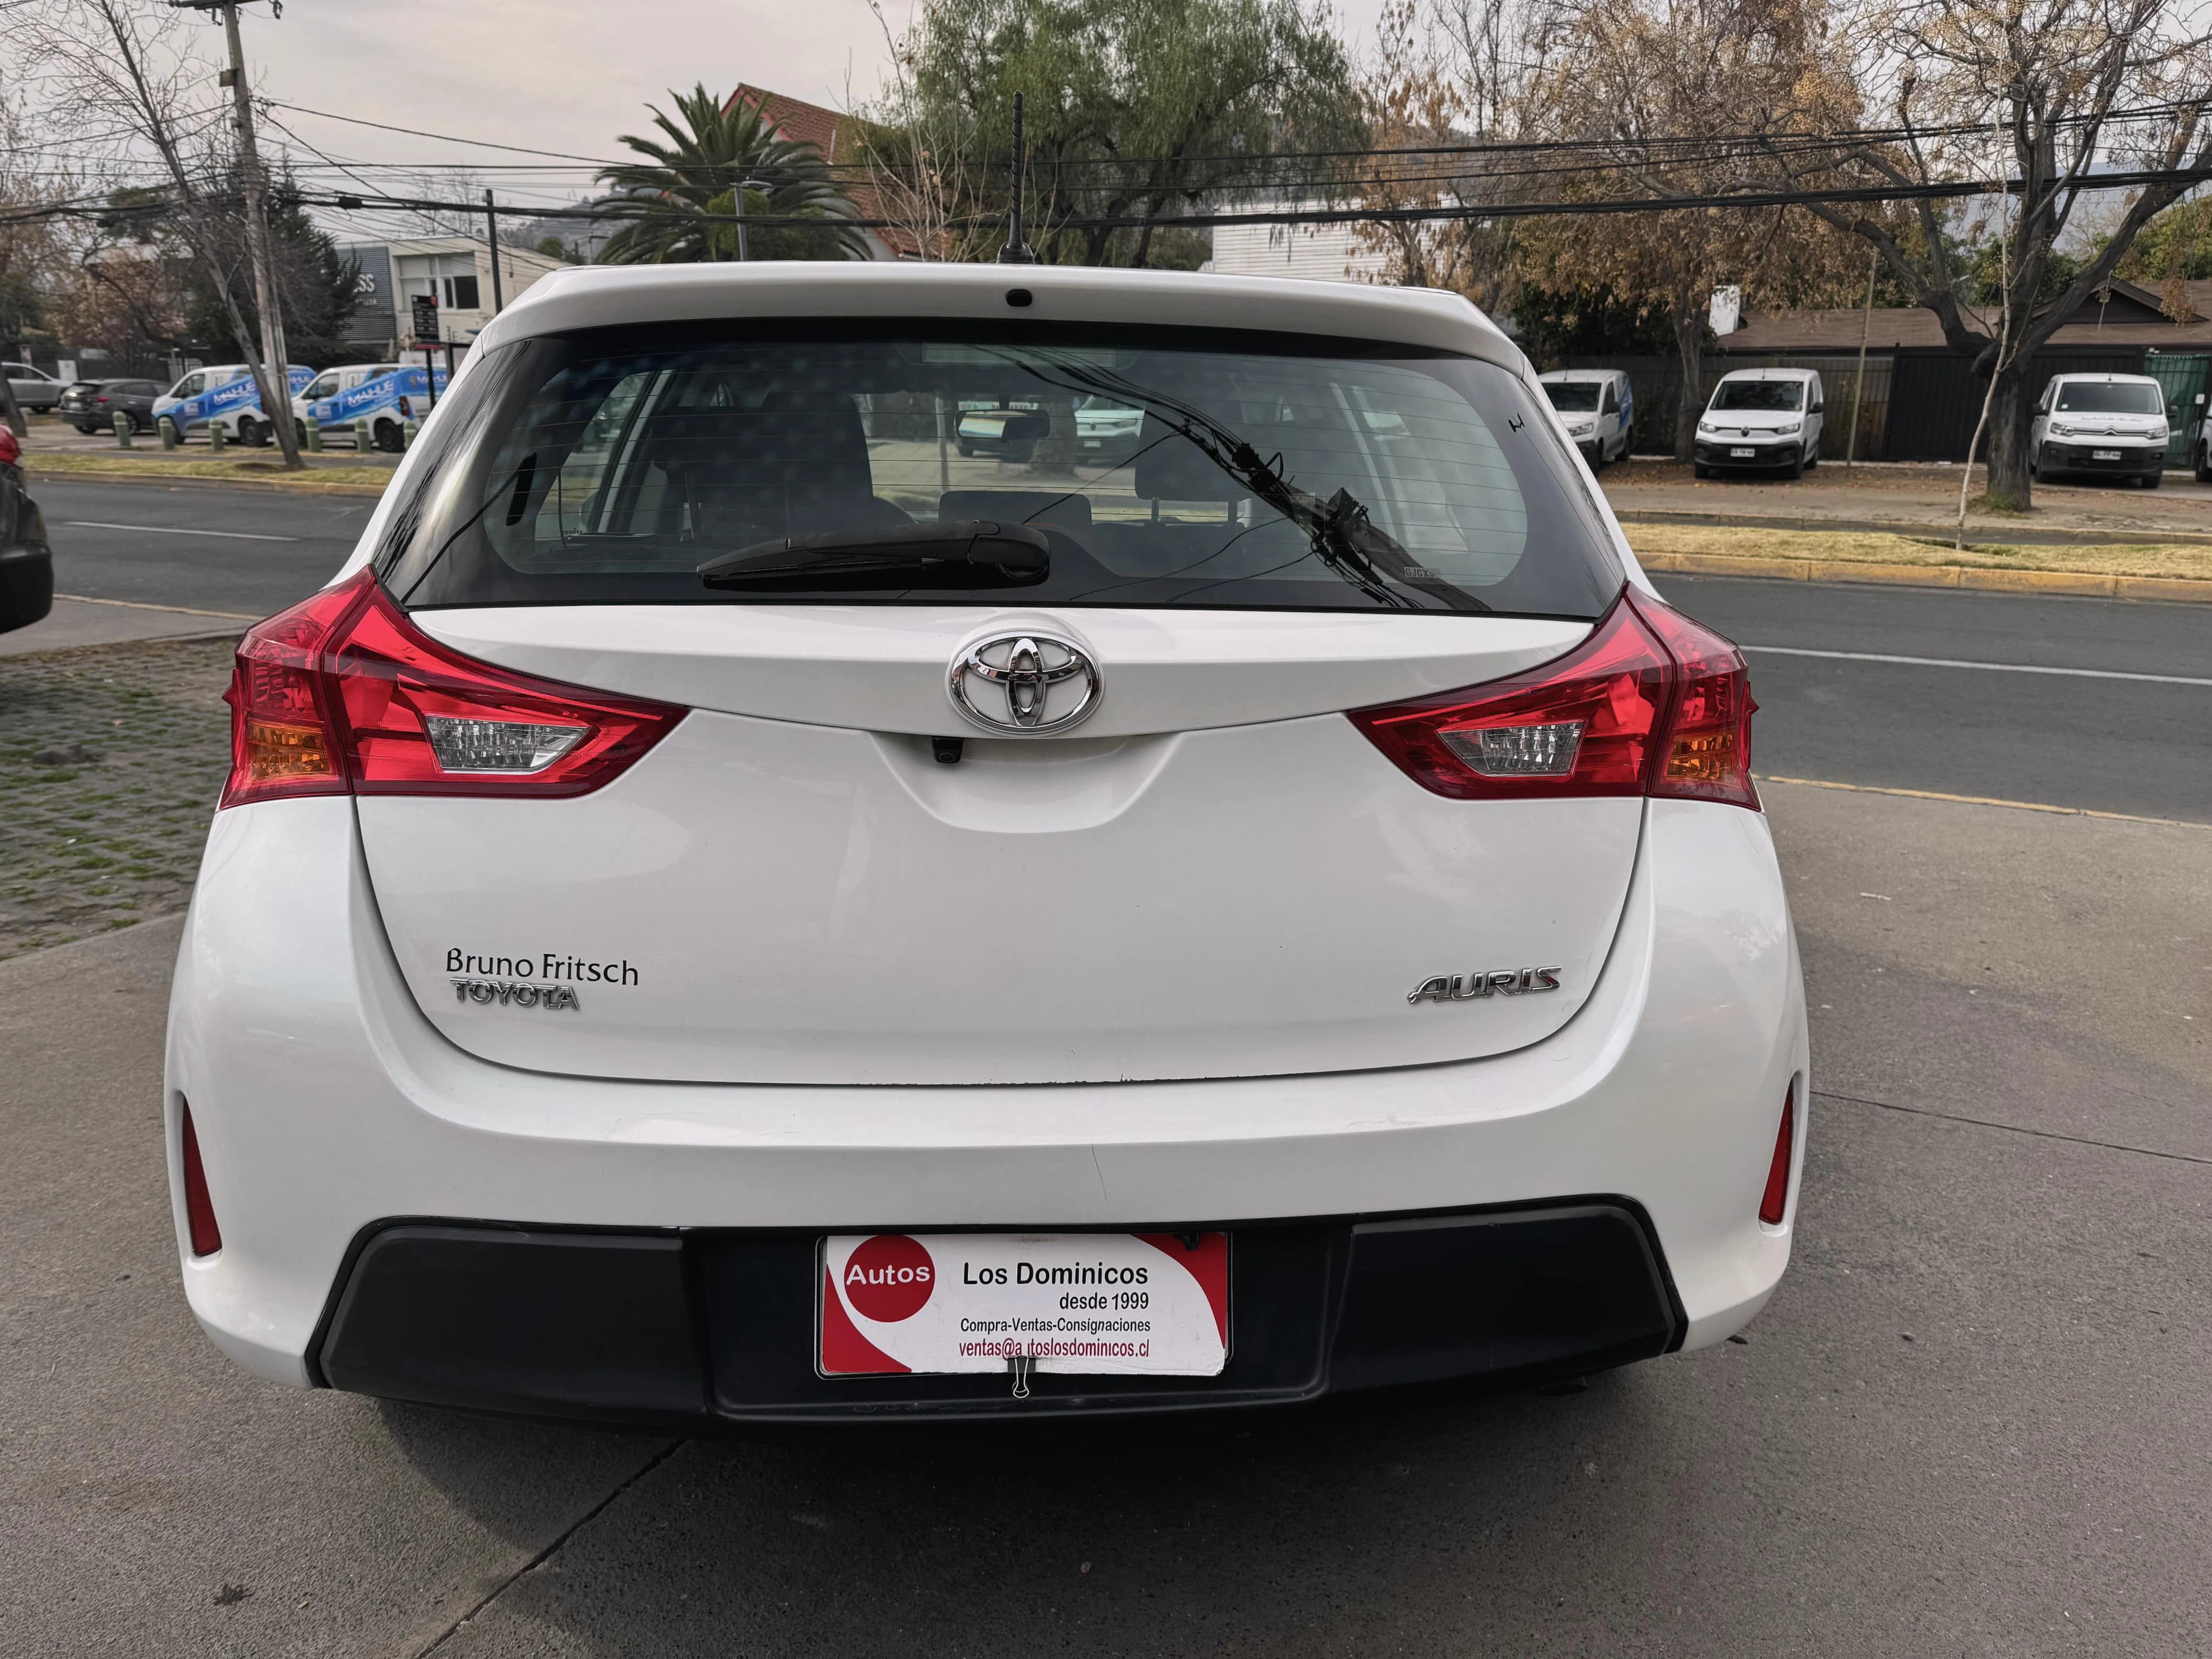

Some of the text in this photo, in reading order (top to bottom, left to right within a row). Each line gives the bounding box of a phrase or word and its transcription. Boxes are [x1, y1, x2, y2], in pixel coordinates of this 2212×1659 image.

[446, 948, 639, 986] Bruno Fritsch
[449, 977, 581, 1010] TOYOTA
[1407, 965, 1562, 1003] AURIS
[846, 1264, 931, 1285] Autos
[963, 1262, 1149, 1285] Los Dominicos
[1059, 1292, 1149, 1310] desde 1999
[960, 1317, 1151, 1335] Compra-Ventas-Consignaciones
